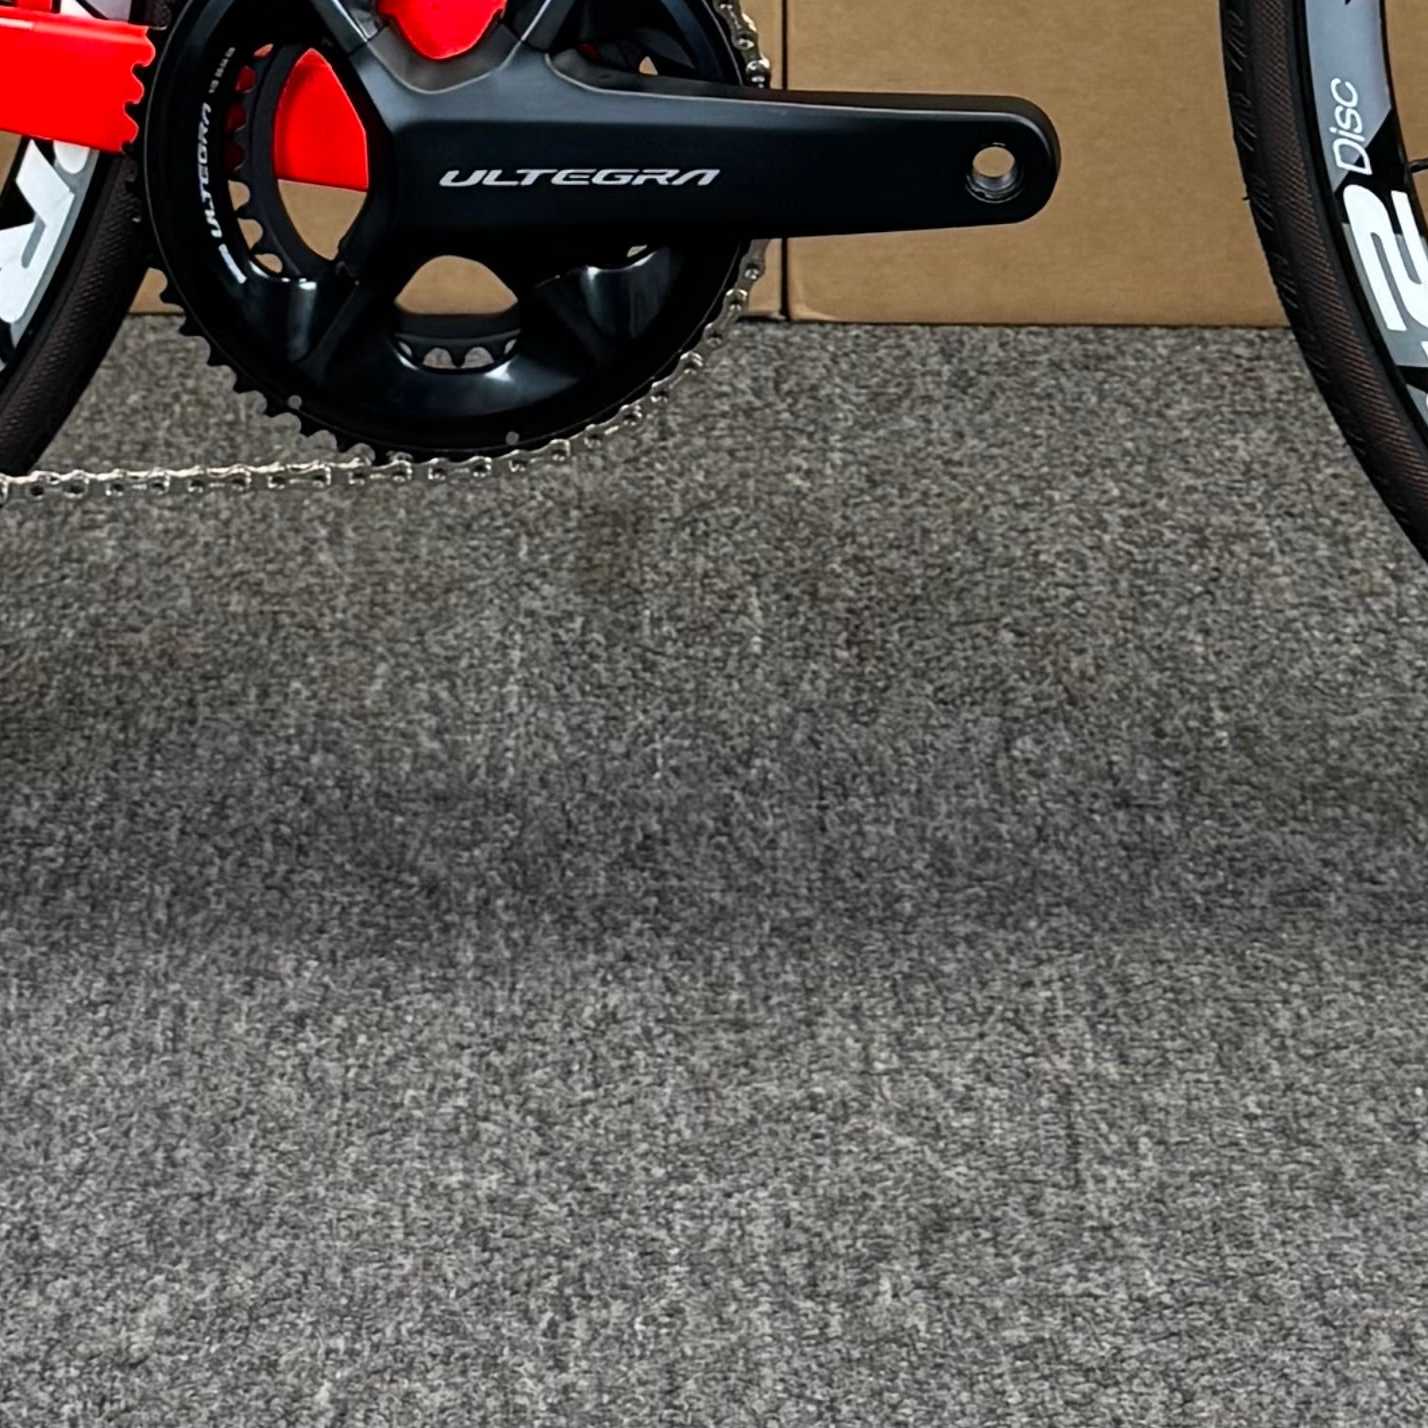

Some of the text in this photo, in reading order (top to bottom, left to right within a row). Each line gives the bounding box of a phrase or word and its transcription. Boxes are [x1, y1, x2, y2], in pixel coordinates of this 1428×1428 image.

[197, 101, 223, 239] ULTEGRA
[1328, 77, 1372, 176] Disc
[438, 167, 720, 188] ULTEGRA
